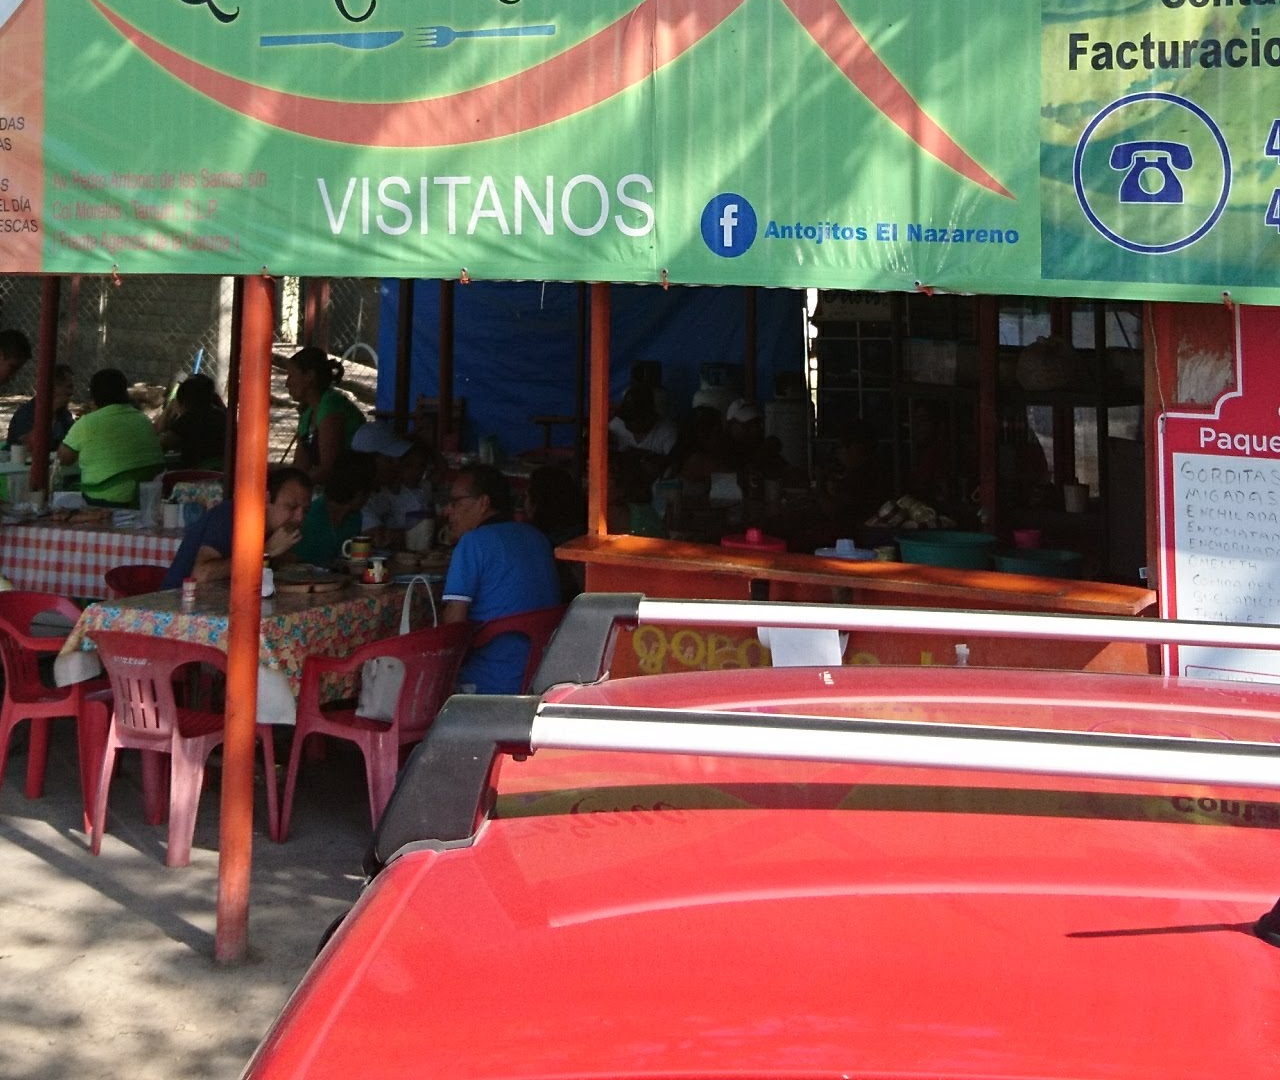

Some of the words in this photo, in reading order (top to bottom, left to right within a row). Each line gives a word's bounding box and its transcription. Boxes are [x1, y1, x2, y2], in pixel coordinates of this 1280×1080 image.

[12, 196, 32, 213] DÍA
[317, 173, 656, 238] VISITANOS
[764, 220, 868, 245] Antojitos
[876, 222, 898, 242] El
[907, 223, 1019, 245] Nazareno
[1185, 489, 1279, 506] MIGADAS
